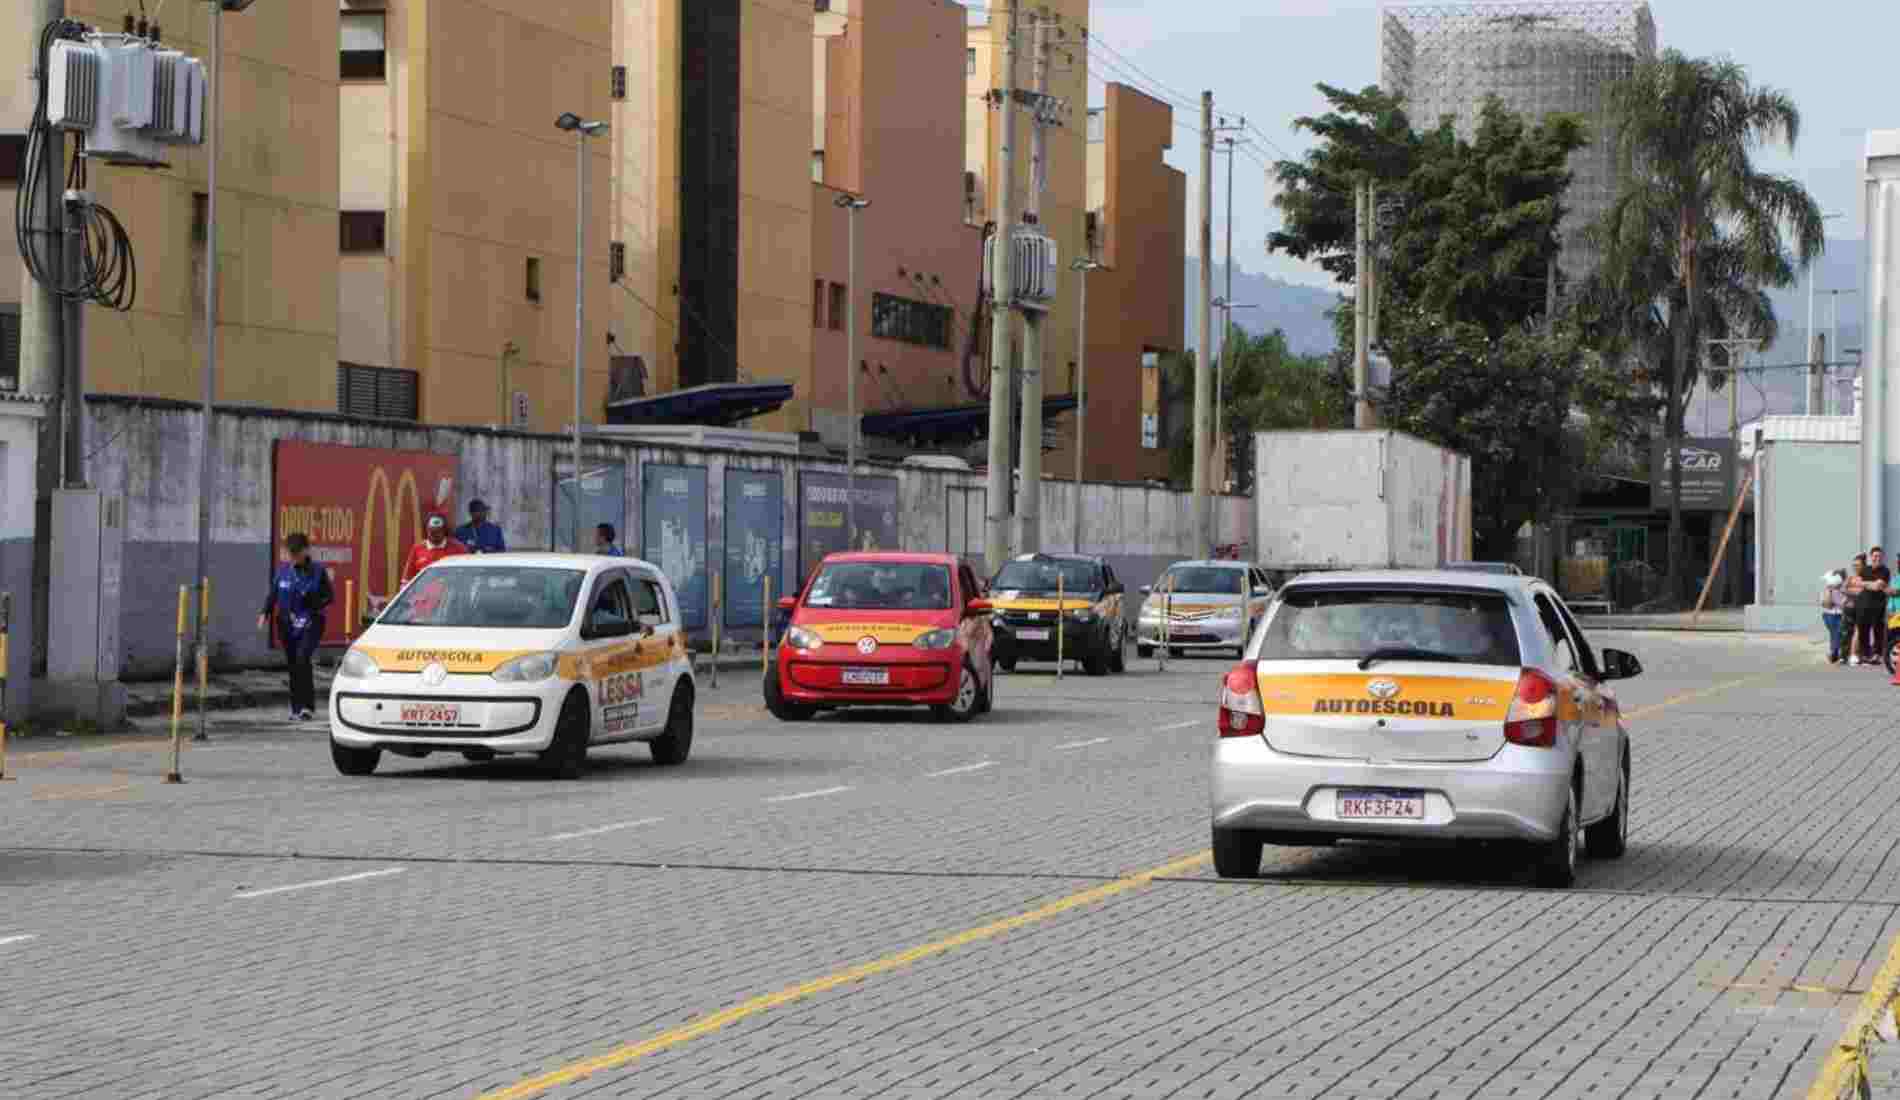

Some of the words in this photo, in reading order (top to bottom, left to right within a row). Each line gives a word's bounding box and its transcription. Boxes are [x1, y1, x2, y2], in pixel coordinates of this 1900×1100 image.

[396, 649, 483, 663] AUTOESCOLA
[598, 672, 644, 706] LESSA
[1313, 698, 1454, 717] AUTOESCOLA
[1343, 799, 1414, 816] RKF3F24
